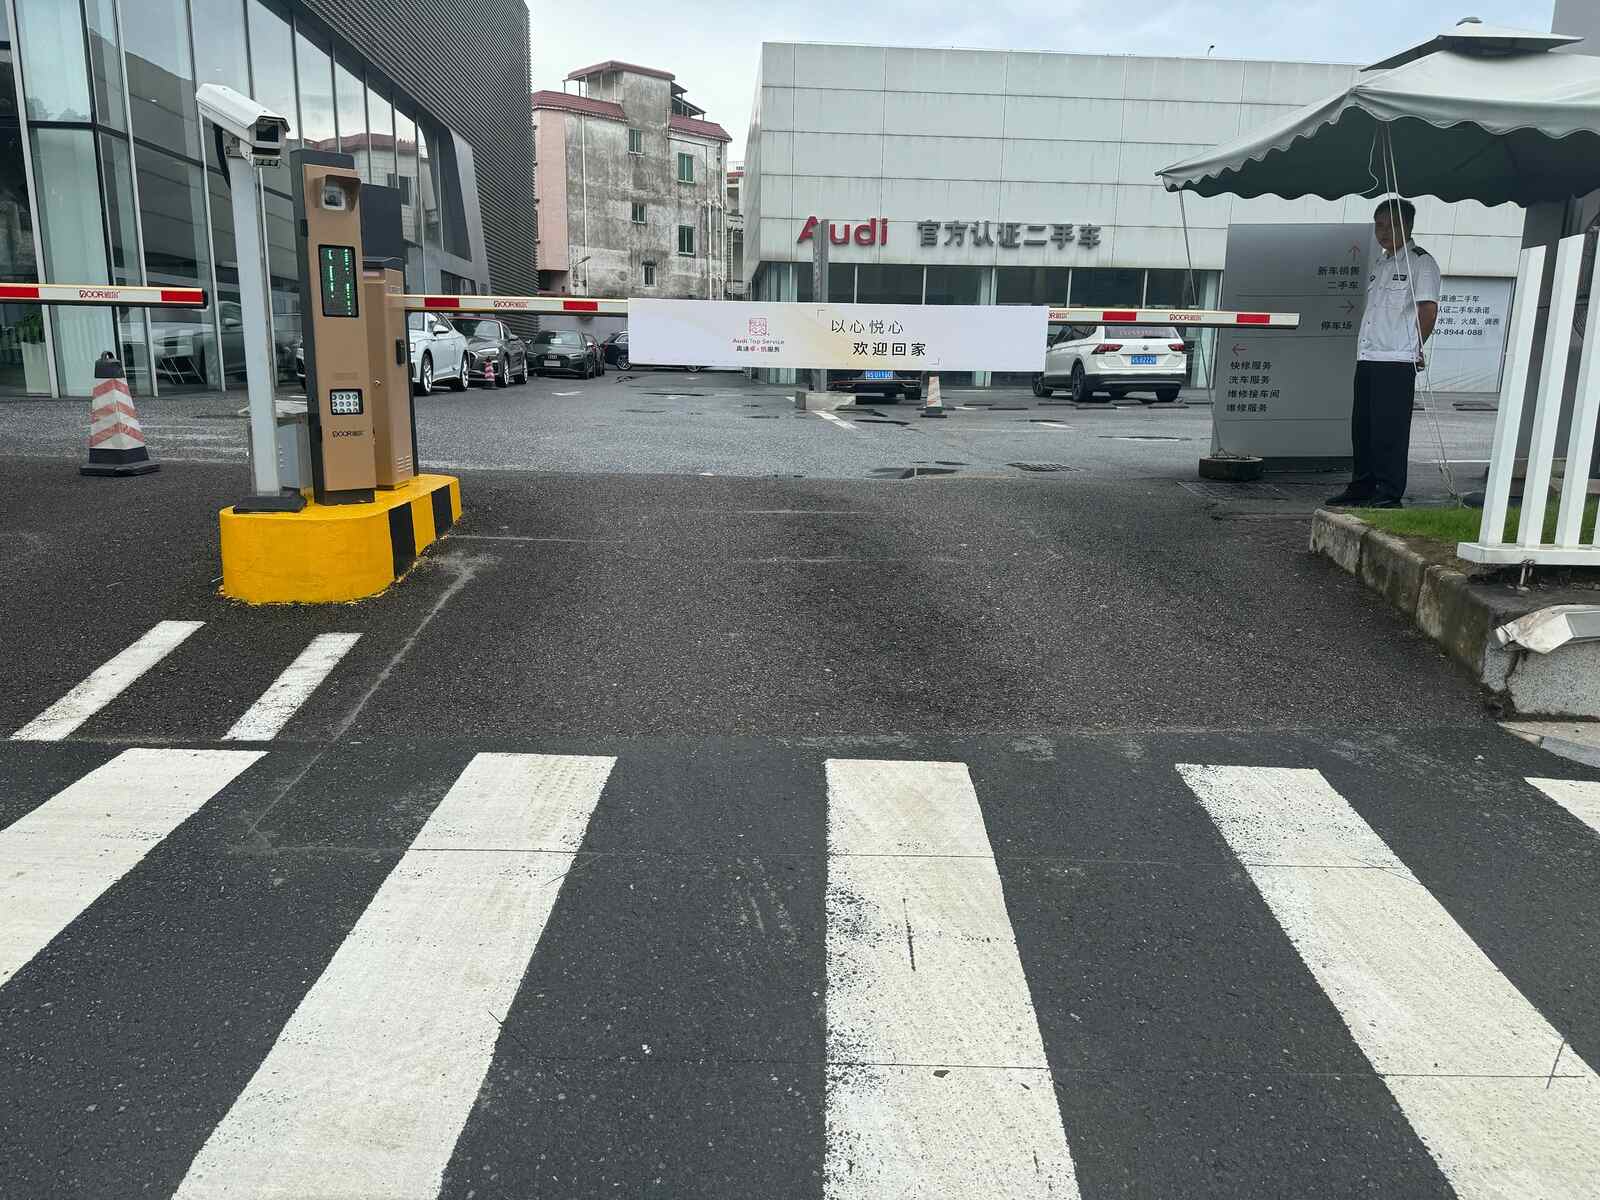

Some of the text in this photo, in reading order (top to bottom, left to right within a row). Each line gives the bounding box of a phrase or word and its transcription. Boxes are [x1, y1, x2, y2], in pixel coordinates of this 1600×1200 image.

[797, 216, 1101, 250] Audi 官方认证二手车
[1327, 281, 1359, 289] 二手车
[1440, 295, 1480, 303] 奥迪二手车
[831, 319, 904, 335] 以心悦心
[1321, 321, 1353, 331] 停车场
[853, 341, 927, 357] 欢迎回家
[1230, 361, 1272, 370] 快修服务
[1228, 376, 1271, 385] 洗车服务
